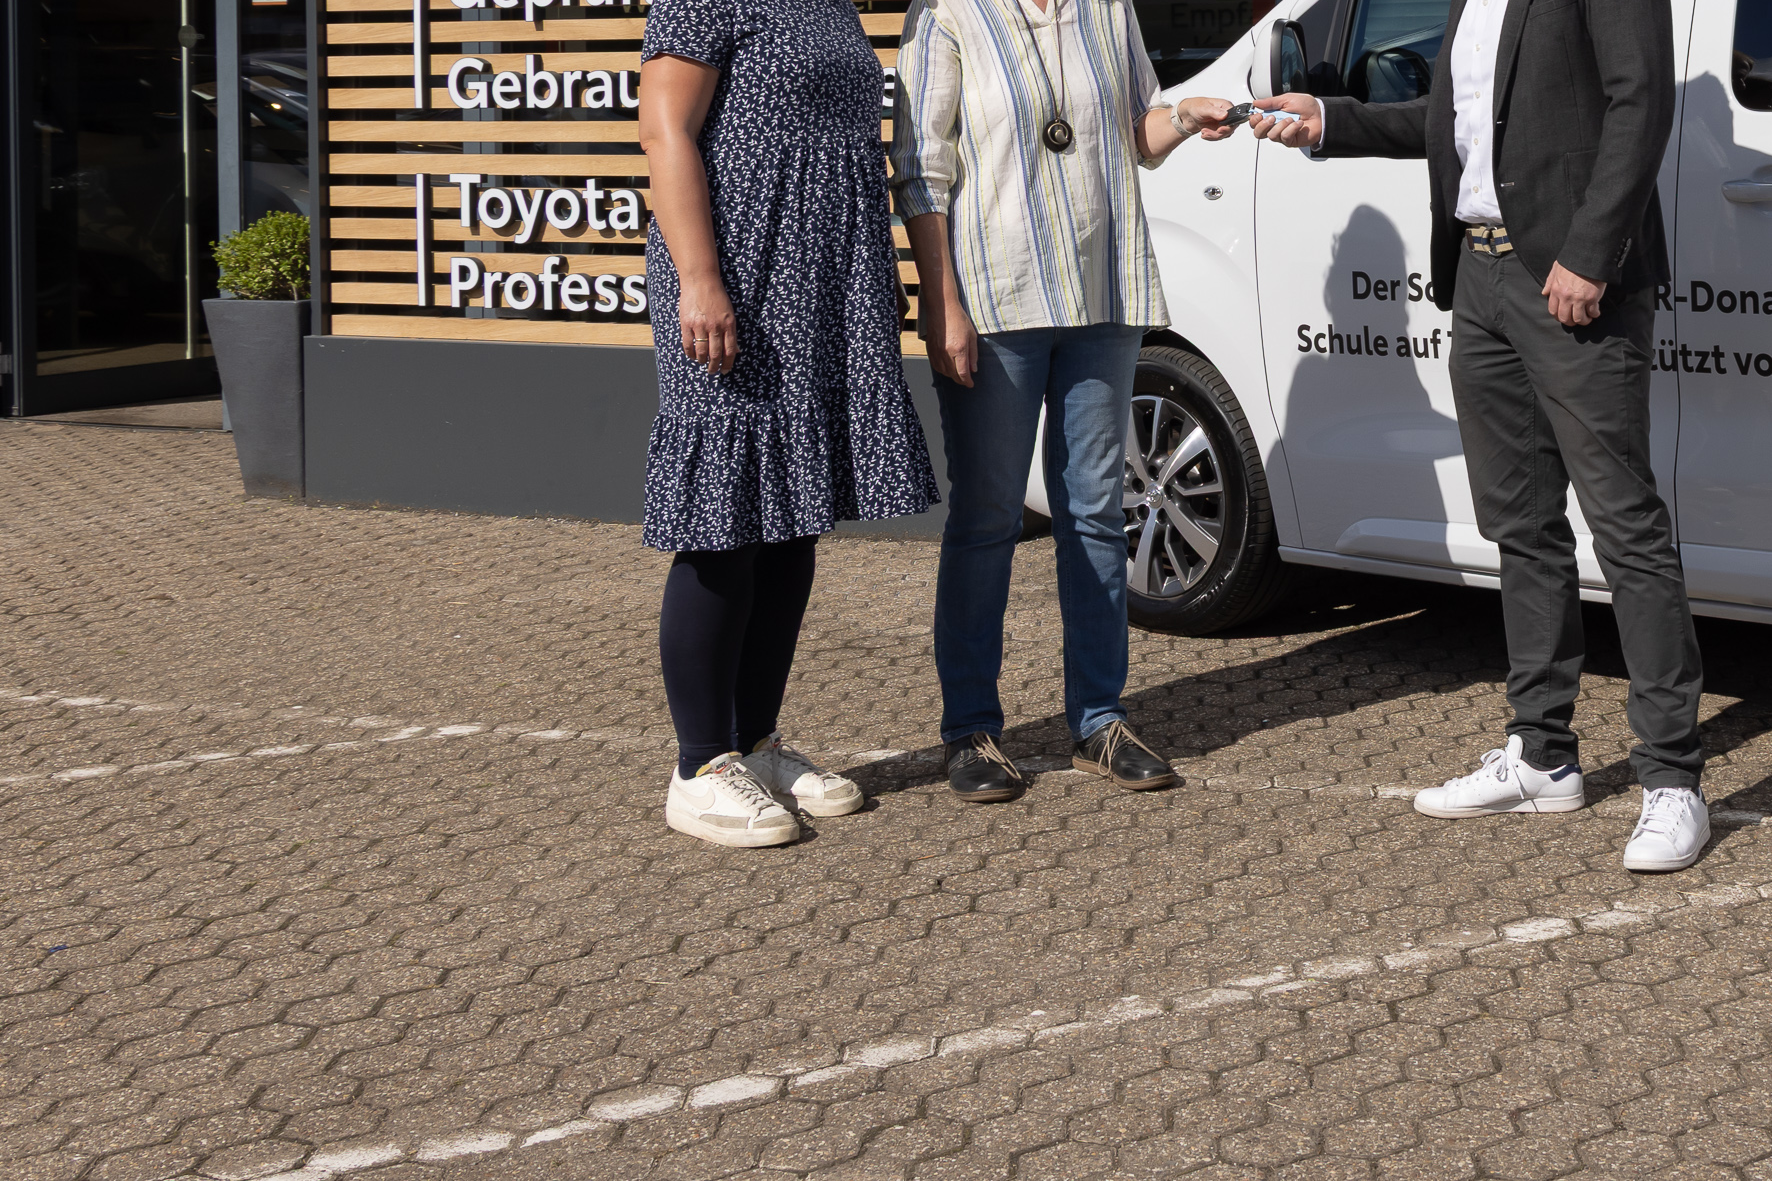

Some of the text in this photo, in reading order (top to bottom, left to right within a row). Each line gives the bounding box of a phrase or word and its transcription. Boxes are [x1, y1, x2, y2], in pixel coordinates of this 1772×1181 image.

[1171, 1, 1253, 34] Empf
[447, 54, 641, 110] Gebrau
[450, 173, 640, 243] Toyota
[450, 257, 647, 313] Profess
[1352, 270, 1401, 301] Der
[1408, 272, 1435, 303] Sc
[1297, 323, 1389, 357] Schule
[1396, 328, 1442, 359] auf
[1650, 339, 1727, 375] ützt
